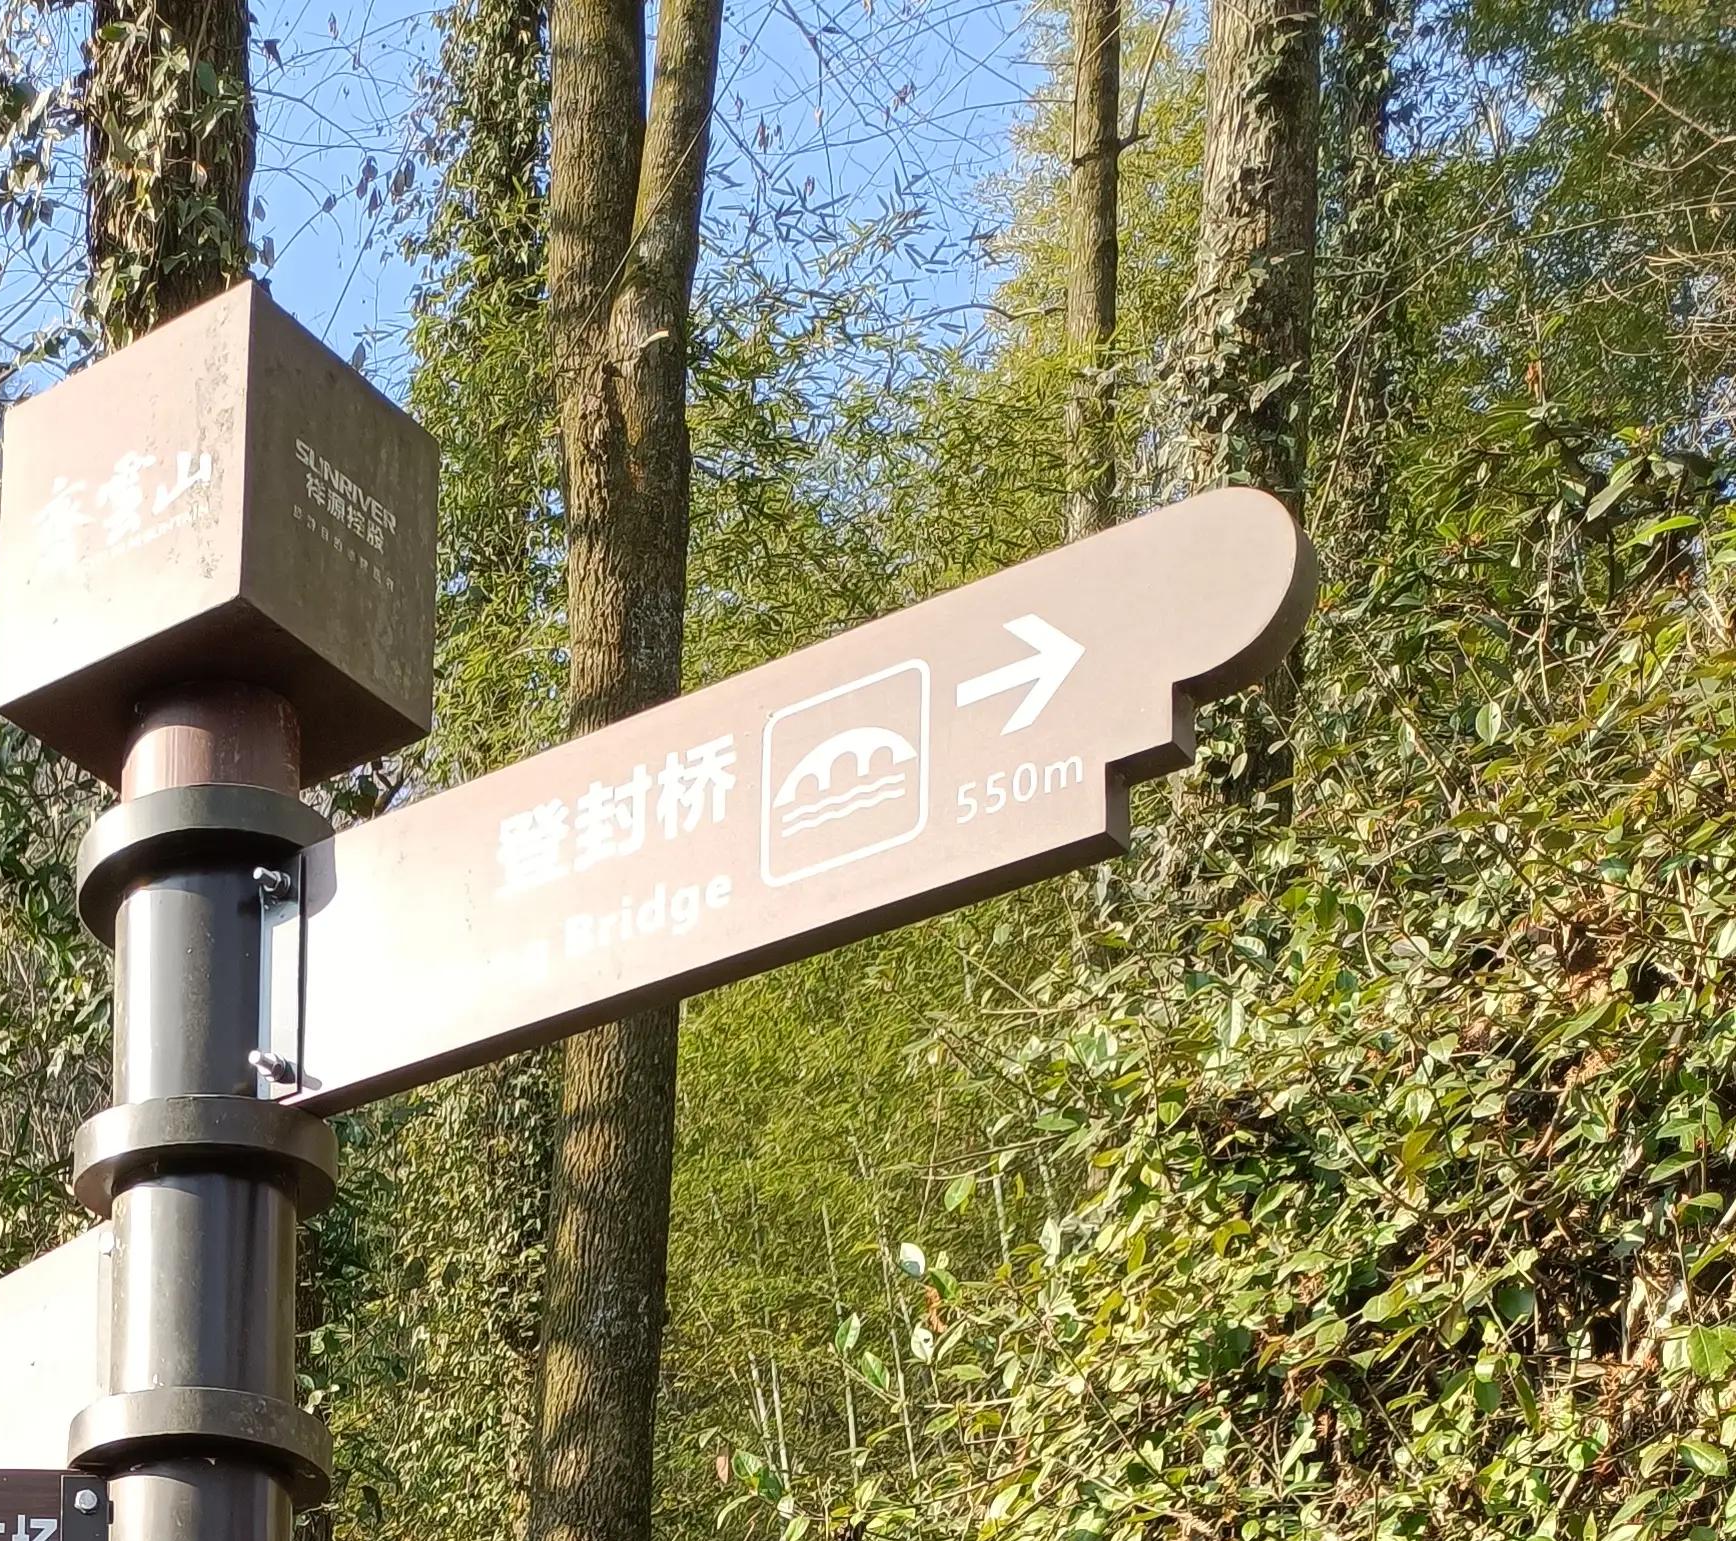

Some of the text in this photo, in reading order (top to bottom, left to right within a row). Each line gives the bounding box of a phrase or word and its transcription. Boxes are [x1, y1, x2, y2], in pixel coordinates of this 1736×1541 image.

[295, 437, 397, 535] SUNRIVER
[304, 472, 384, 555] 祥源控股
[493, 732, 739, 902] 登封桥
[955, 754, 1085, 826] 550m
